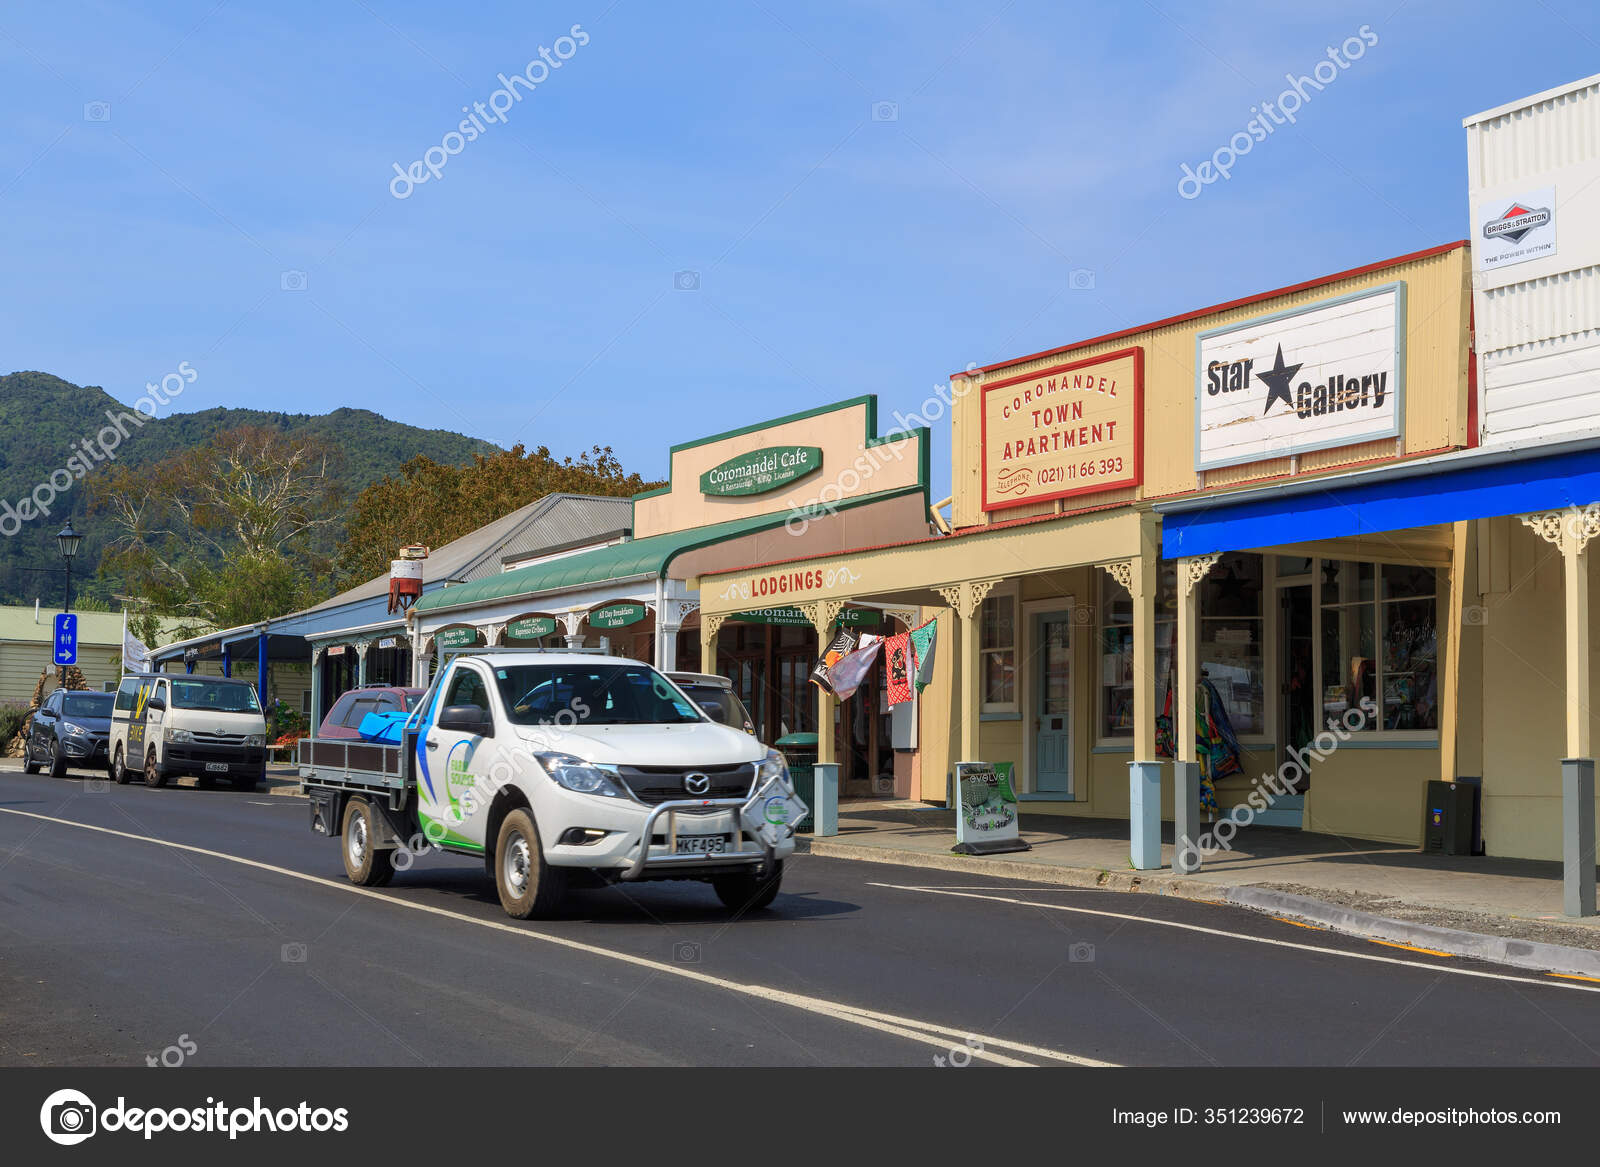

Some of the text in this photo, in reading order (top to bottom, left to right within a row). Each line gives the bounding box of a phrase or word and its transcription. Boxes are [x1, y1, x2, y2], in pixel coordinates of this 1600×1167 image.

[1485, 243, 1551, 264] THE POWER WITHIN
[1003, 375, 1117, 420] COROMANDEL
[1207, 358, 1388, 420] Star Gallery
[1031, 401, 1083, 430] TOWN
[1002, 420, 1117, 461] APARTMENT
[709, 447, 808, 484] Coromandel Cafe
[1037, 465, 1064, 485] (021)
[1068, 464, 1077, 480] 11
[1080, 460, 1096, 477] 66
[1099, 456, 1123, 475] 393
[751, 570, 823, 598] LODGINGS
